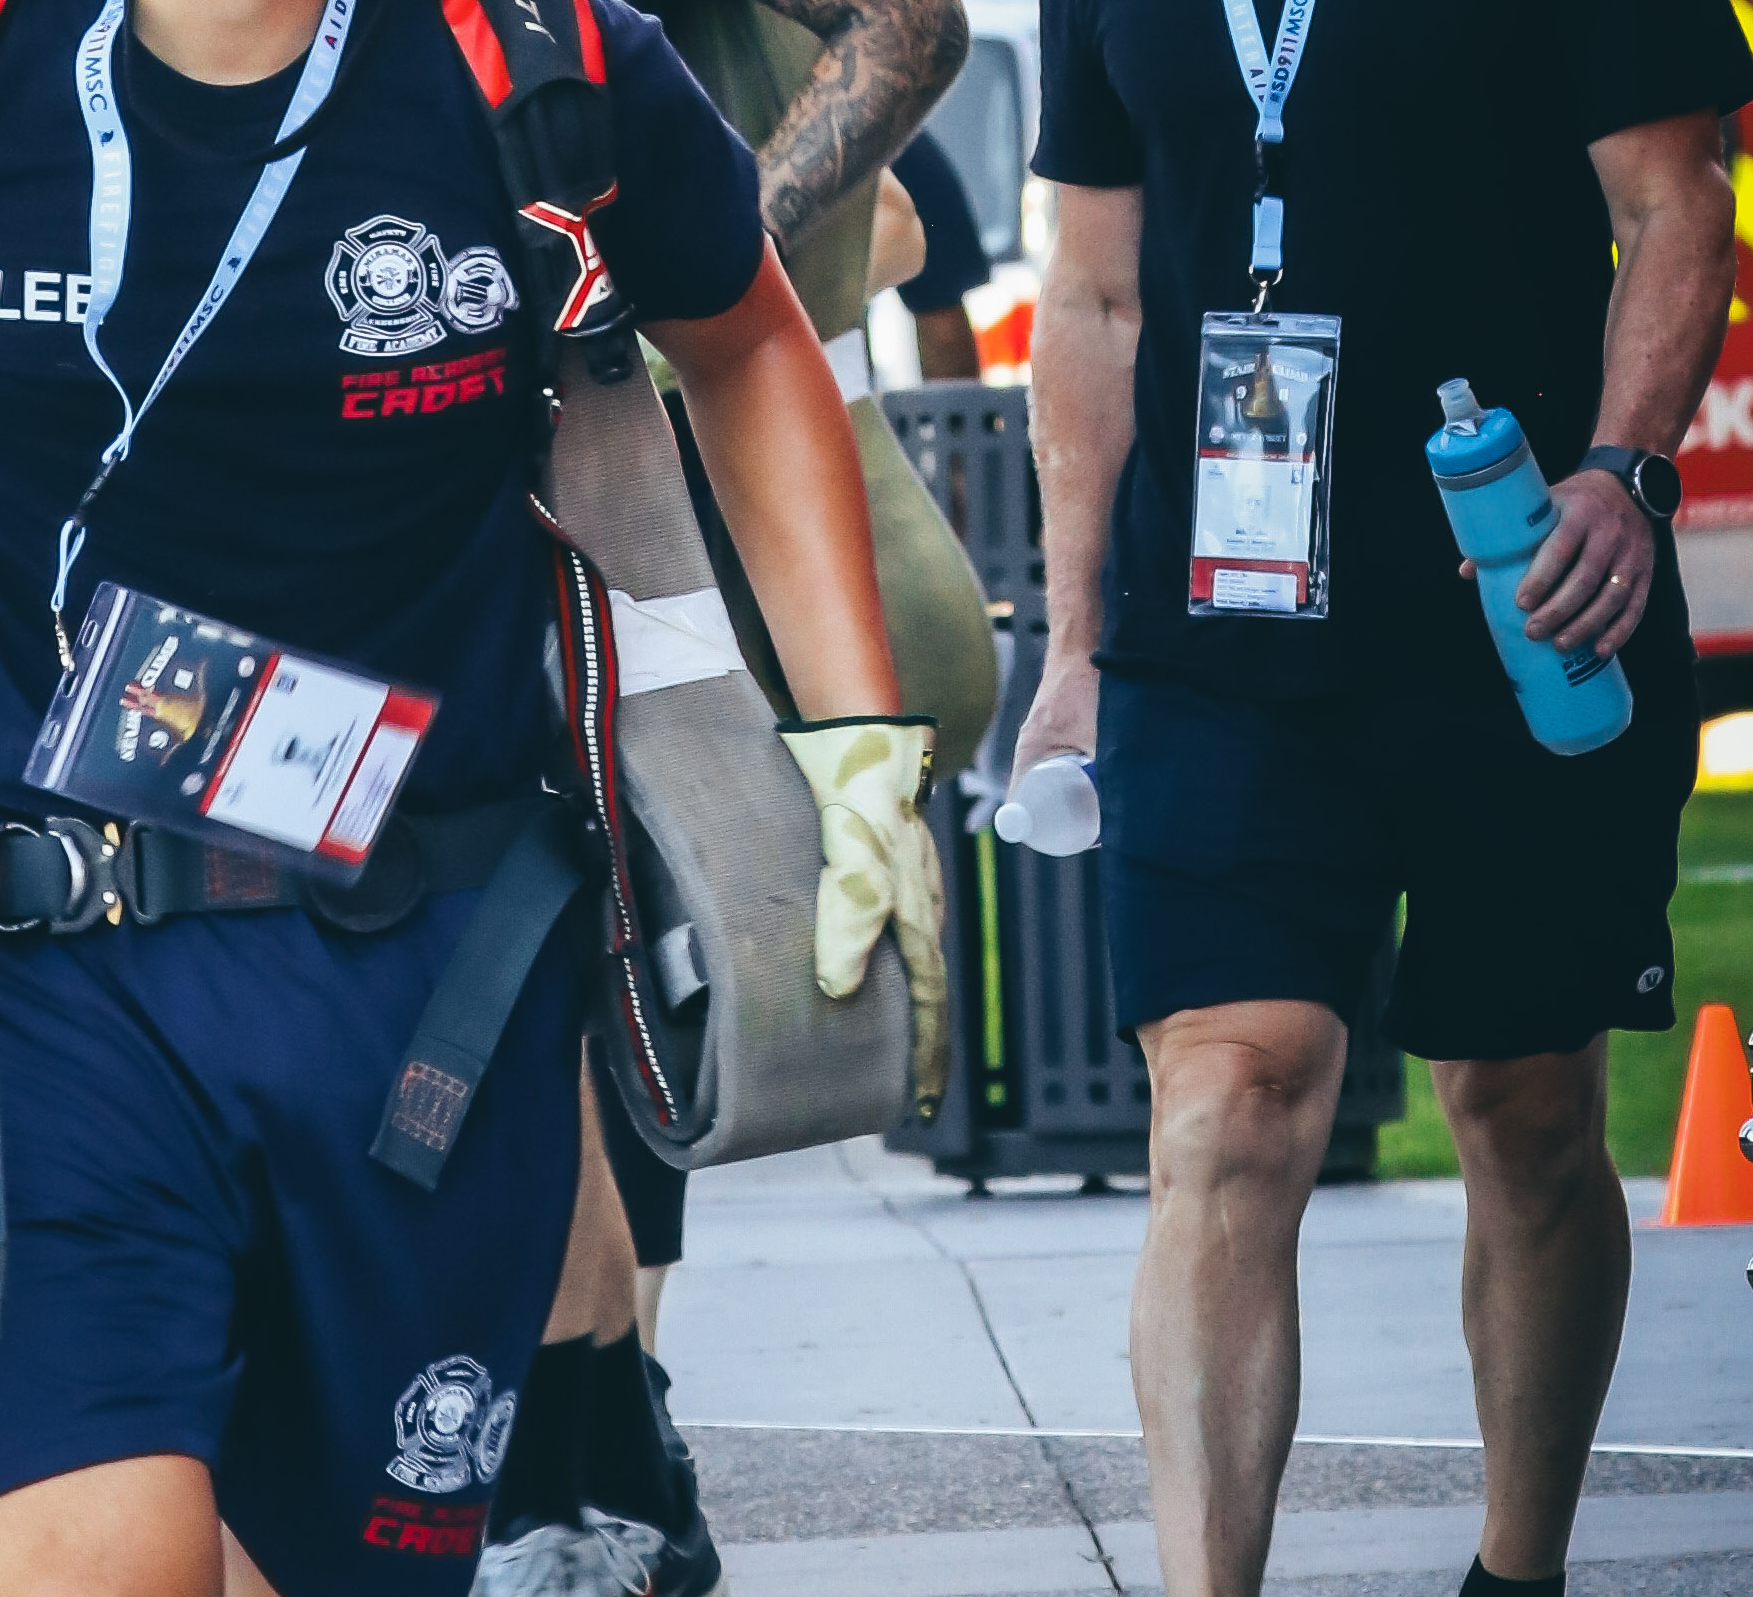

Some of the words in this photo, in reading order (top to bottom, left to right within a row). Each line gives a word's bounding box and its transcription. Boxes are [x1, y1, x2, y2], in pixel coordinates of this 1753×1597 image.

[348, 335, 379, 352] FIRE
[383, 326, 439, 353] ACADEMY
[342, 364, 505, 418] CADET
